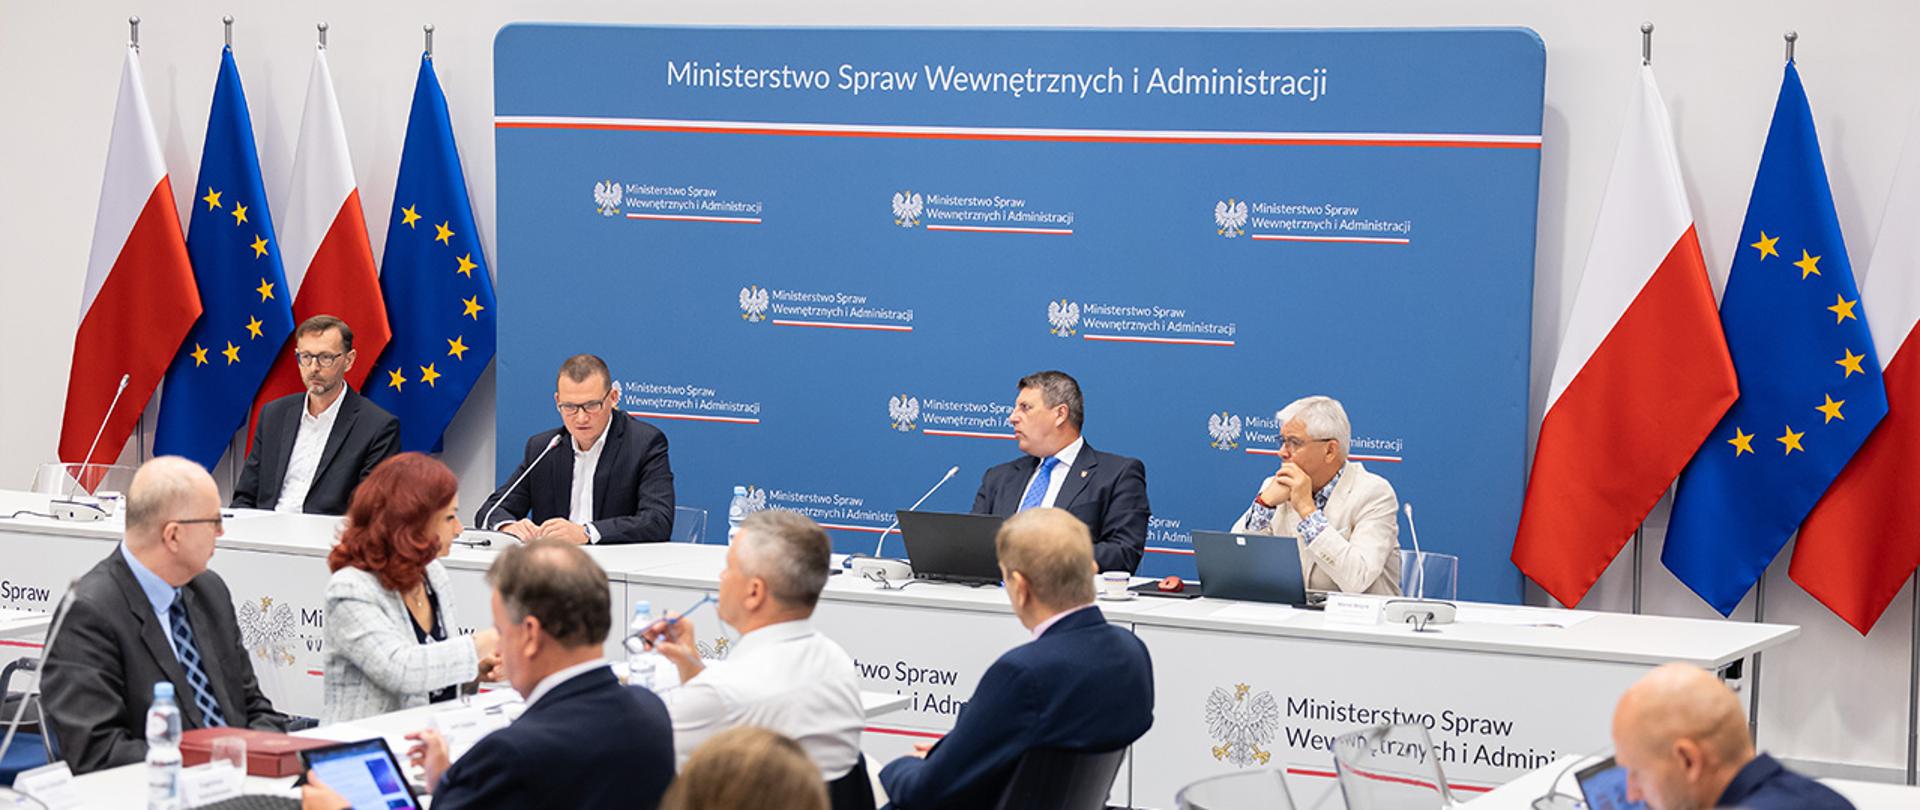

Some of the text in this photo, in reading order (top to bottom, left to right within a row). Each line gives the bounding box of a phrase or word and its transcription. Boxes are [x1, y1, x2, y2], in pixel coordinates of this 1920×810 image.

[667, 61, 1328, 101] Ministerstwo Spraw Wewnętrznych i Administracji
[626, 184, 717, 198] Ministerstwo Spraw
[626, 197, 762, 215] Wewnętrznych i Administracji
[927, 194, 1025, 209] Ministerstwo Spraw
[1252, 202, 1359, 217] Ministerstwo Spraw
[927, 208, 1074, 225] Wewnętrznych i Administracji
[1252, 216, 1411, 234] Wewnętrznych i Administracji
[772, 290, 867, 305] Ministerstwo Spraw
[772, 304, 913, 322] Wewnętrznych i Administracji
[1083, 303, 1185, 318] Ministerstwo Spraw
[1083, 318, 1236, 336] Wewnętrznych i Administracji
[625, 382, 716, 398] Ministerstwo Spraw
[625, 395, 760, 415] Wewnętrznych i Administracji
[923, 399, 1014, 415] Ministerstwo Spra
[922, 413, 997, 427] Wewnętrznych
[998, 415, 1002, 427] i
[1245, 416, 1280, 429] Minist
[770, 489, 863, 507] Ministerstwo Spraw
[841, 508, 845, 519] i
[1148, 515, 1180, 528] Spraw
[1, 580, 50, 602] Spraw
[895, 661, 958, 686] Spraw
[913, 691, 918, 711] i
[1286, 697, 1513, 736] Ministerstwo Spraw
[1463, 743, 1467, 763] i
